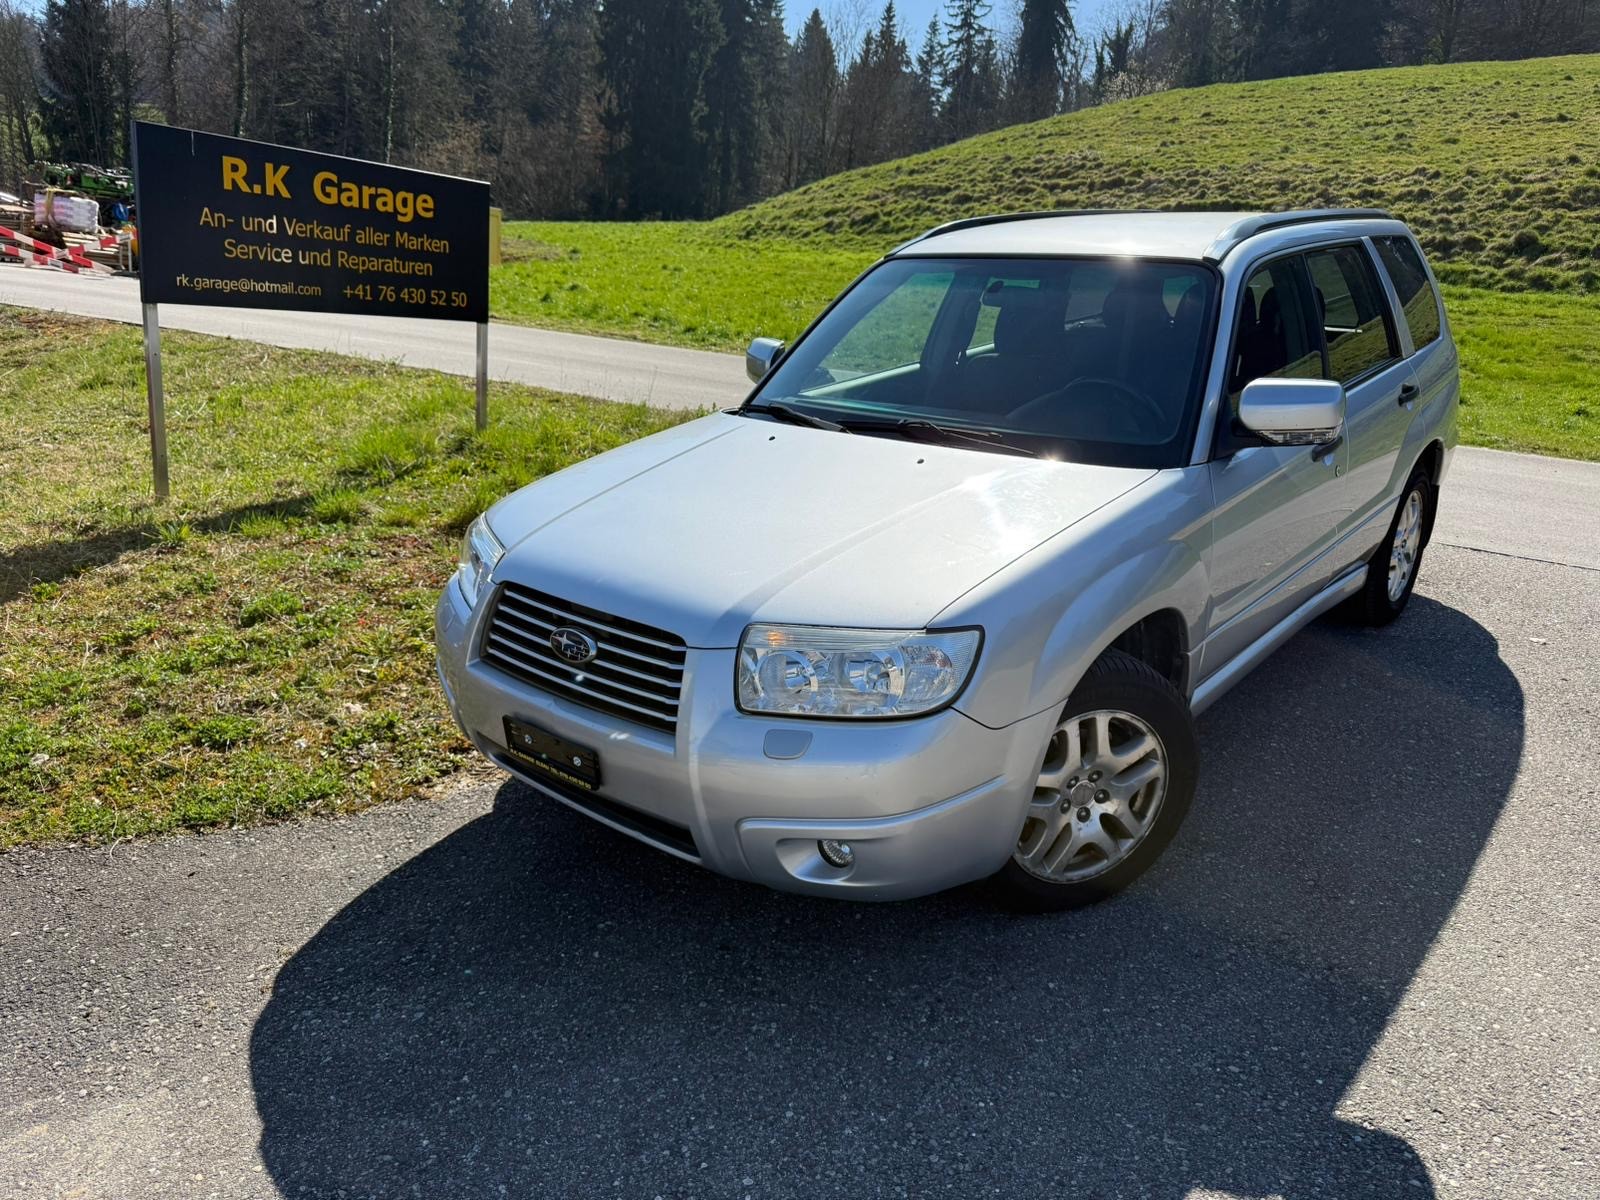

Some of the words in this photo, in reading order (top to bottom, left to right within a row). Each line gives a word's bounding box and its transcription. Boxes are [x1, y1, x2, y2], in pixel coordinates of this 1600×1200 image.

[222, 156, 292, 199] R.K
[313, 171, 435, 223] Garage
[200, 207, 234, 228] An-
[242, 215, 277, 234] und
[283, 217, 351, 242] Verkauf
[356, 227, 390, 246] aller
[395, 231, 449, 253] Marken
[224, 239, 292, 263] Service
[299, 249, 331, 266] und
[338, 251, 433, 276] Reparaturen
[176, 273, 322, 296] rk.garage@hotmail.com
[343, 284, 373, 301] +41
[378, 286, 396, 302] 76
[400, 288, 426, 304] 430
[431, 290, 447, 306] 52
[451, 292, 467, 307] 50
